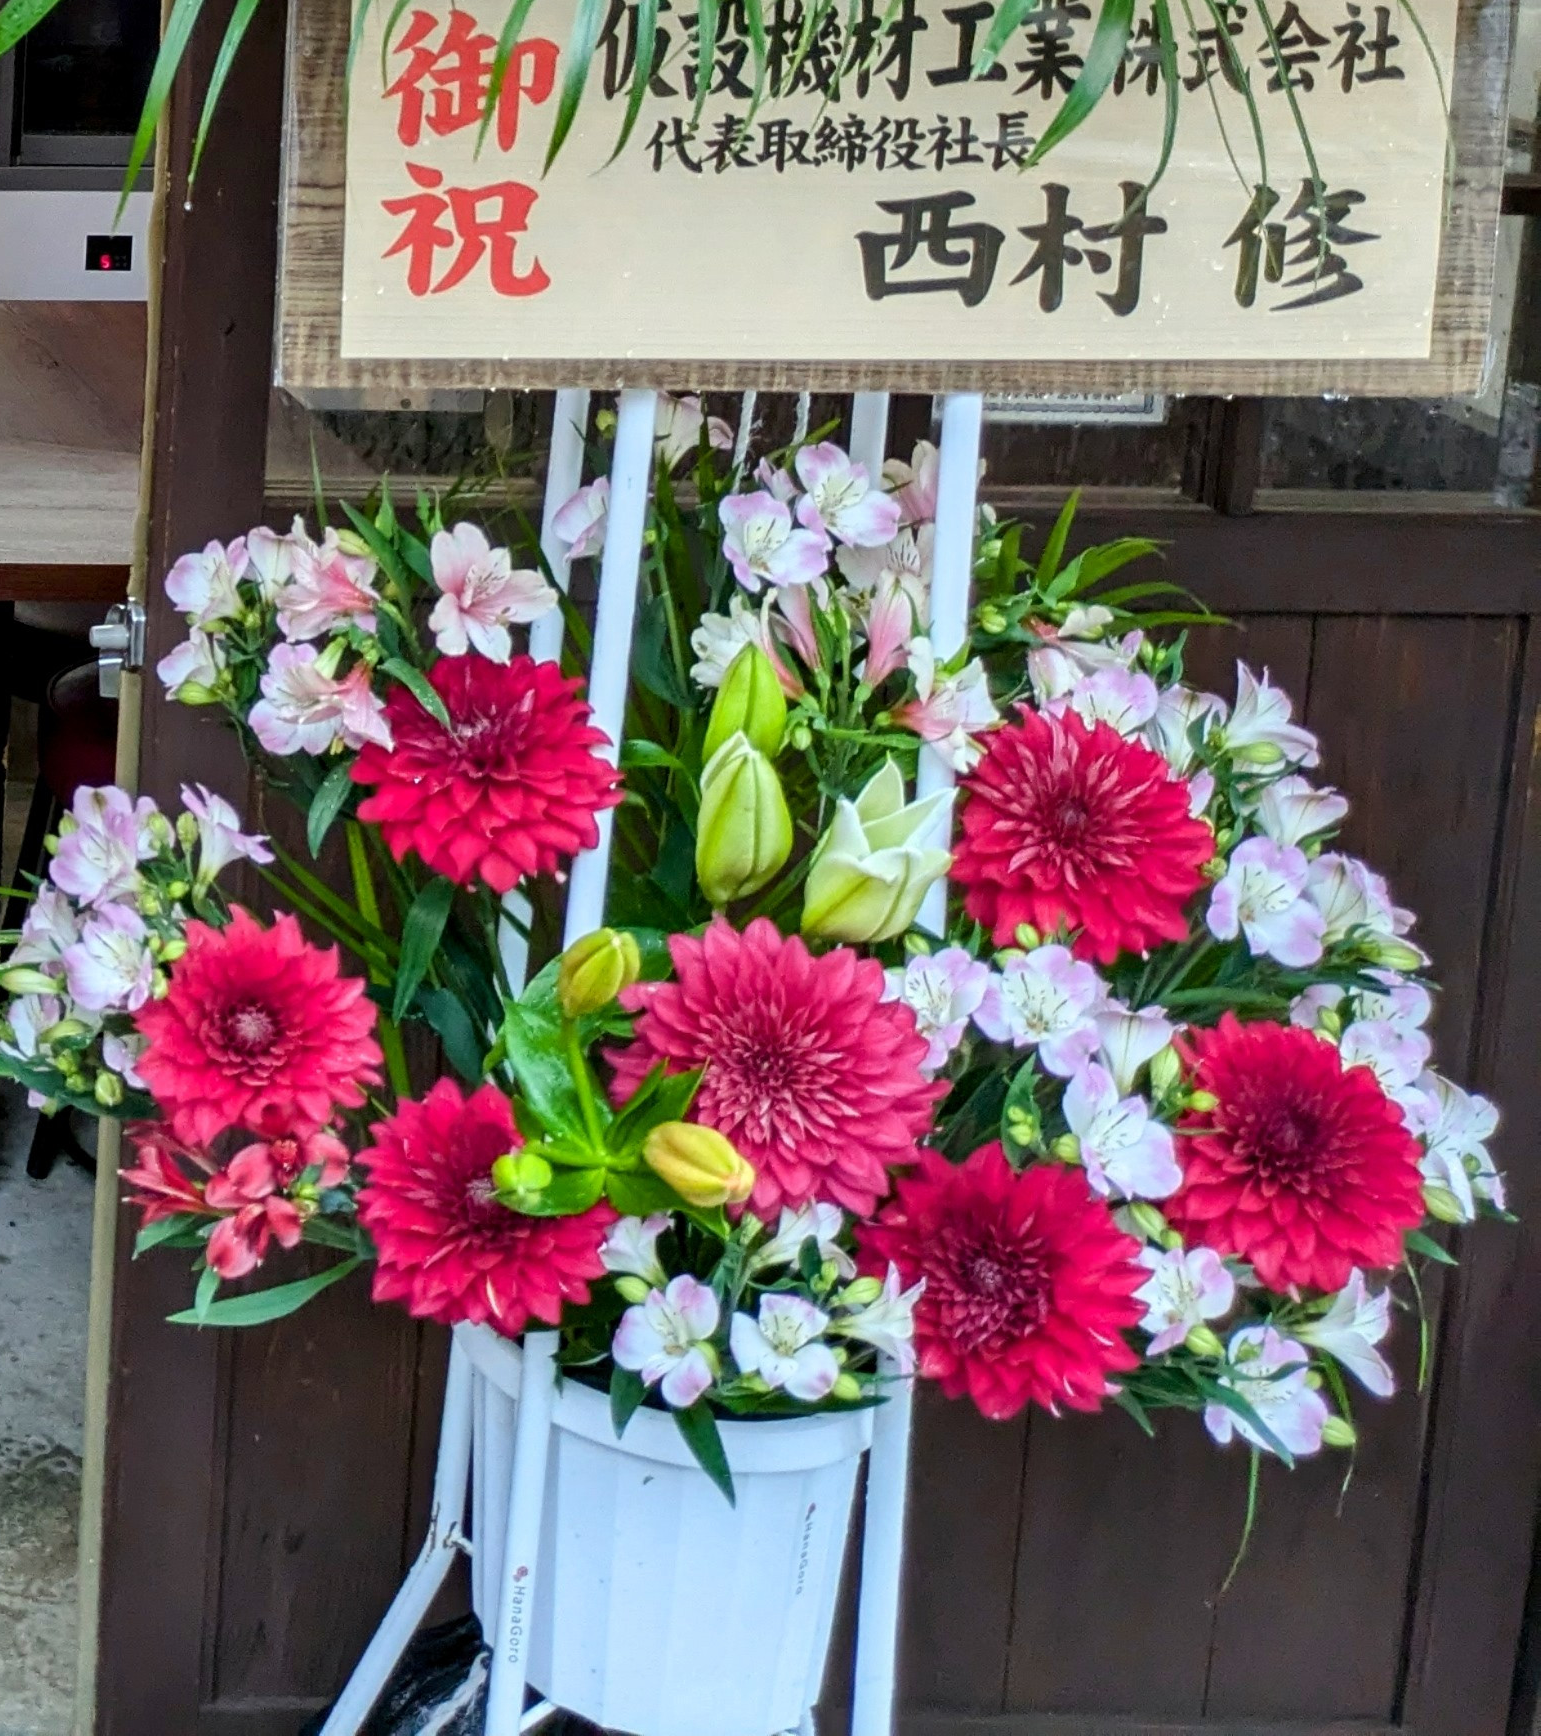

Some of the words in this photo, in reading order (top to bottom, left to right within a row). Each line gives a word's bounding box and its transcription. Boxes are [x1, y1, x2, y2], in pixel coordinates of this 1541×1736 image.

[382, 8, 559, 298] 御祝
[644, 109, 1038, 174] 代表取締役社長
[854, 179, 1169, 317] 西村
[1220, 176, 1382, 312] 修
[794, 1520, 814, 1596] HanaGoro
[507, 1585, 527, 1664] HanaGoro
